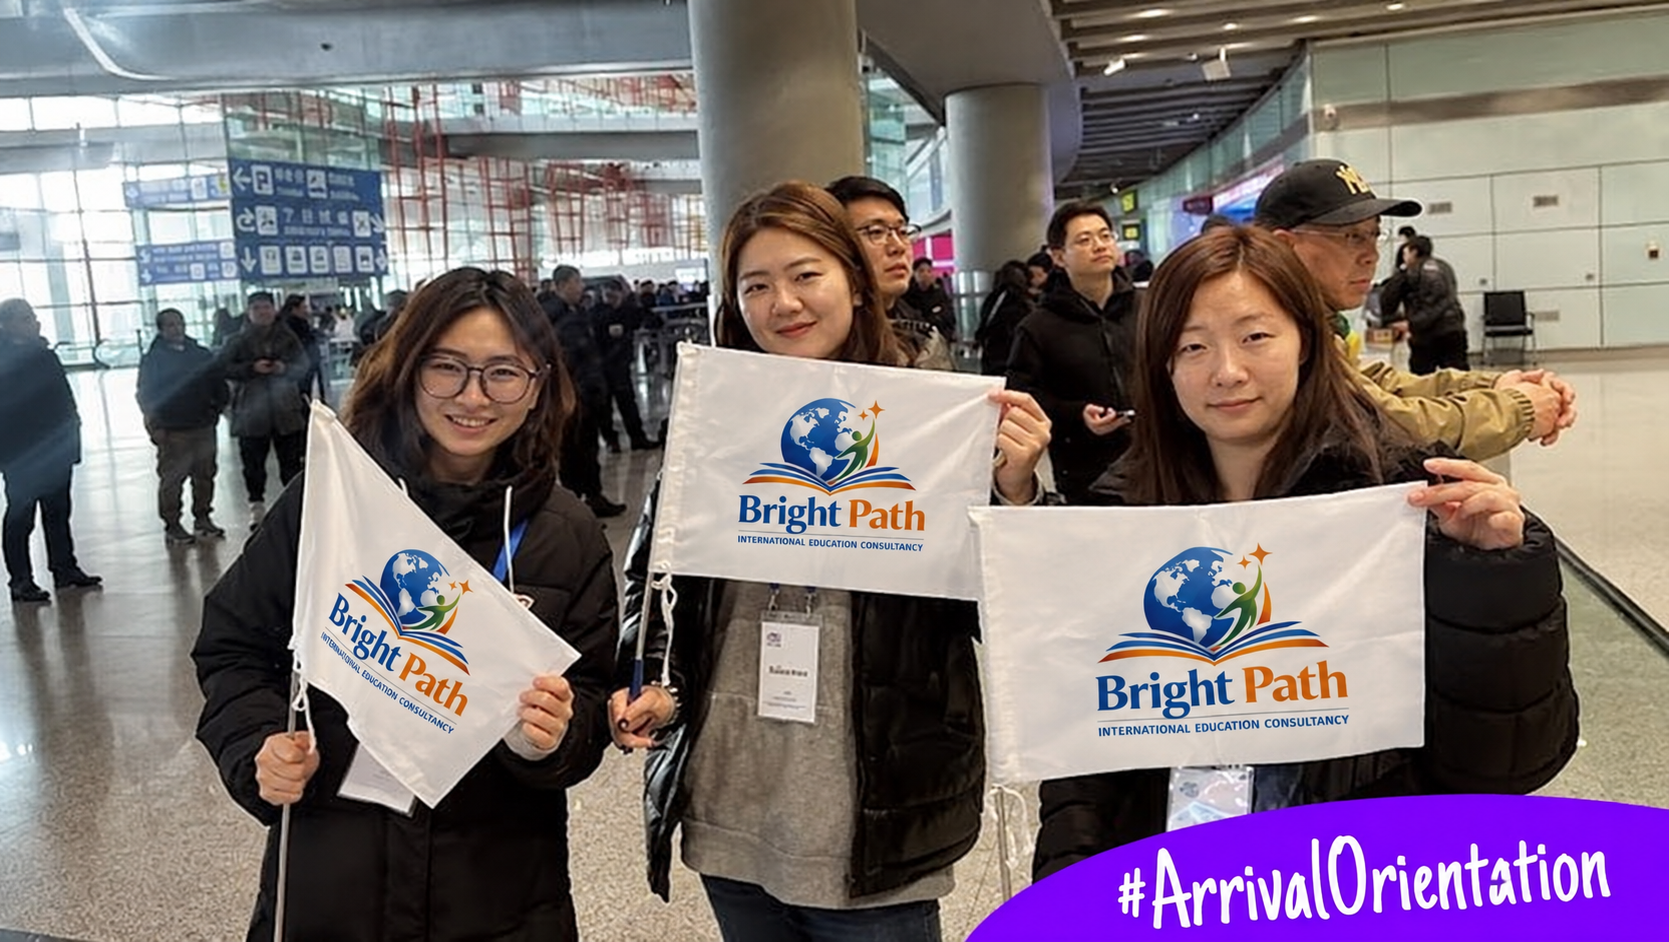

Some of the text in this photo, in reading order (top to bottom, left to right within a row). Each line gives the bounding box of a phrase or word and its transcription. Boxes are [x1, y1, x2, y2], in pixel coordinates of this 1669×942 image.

[738, 494, 925, 534] Bright Path
[738, 535, 924, 551] INTERNATIONAL EDUCATION CONSULTANCY
[329, 592, 469, 716] Bright Path
[361, 669, 398, 700] EDUCATION
[399, 697, 455, 734] CONSULTANCY
[1095, 660, 1348, 719] Bright Path
[1098, 715, 1350, 737] INTERNATIONAL EDUCATION CONSULTANCY
